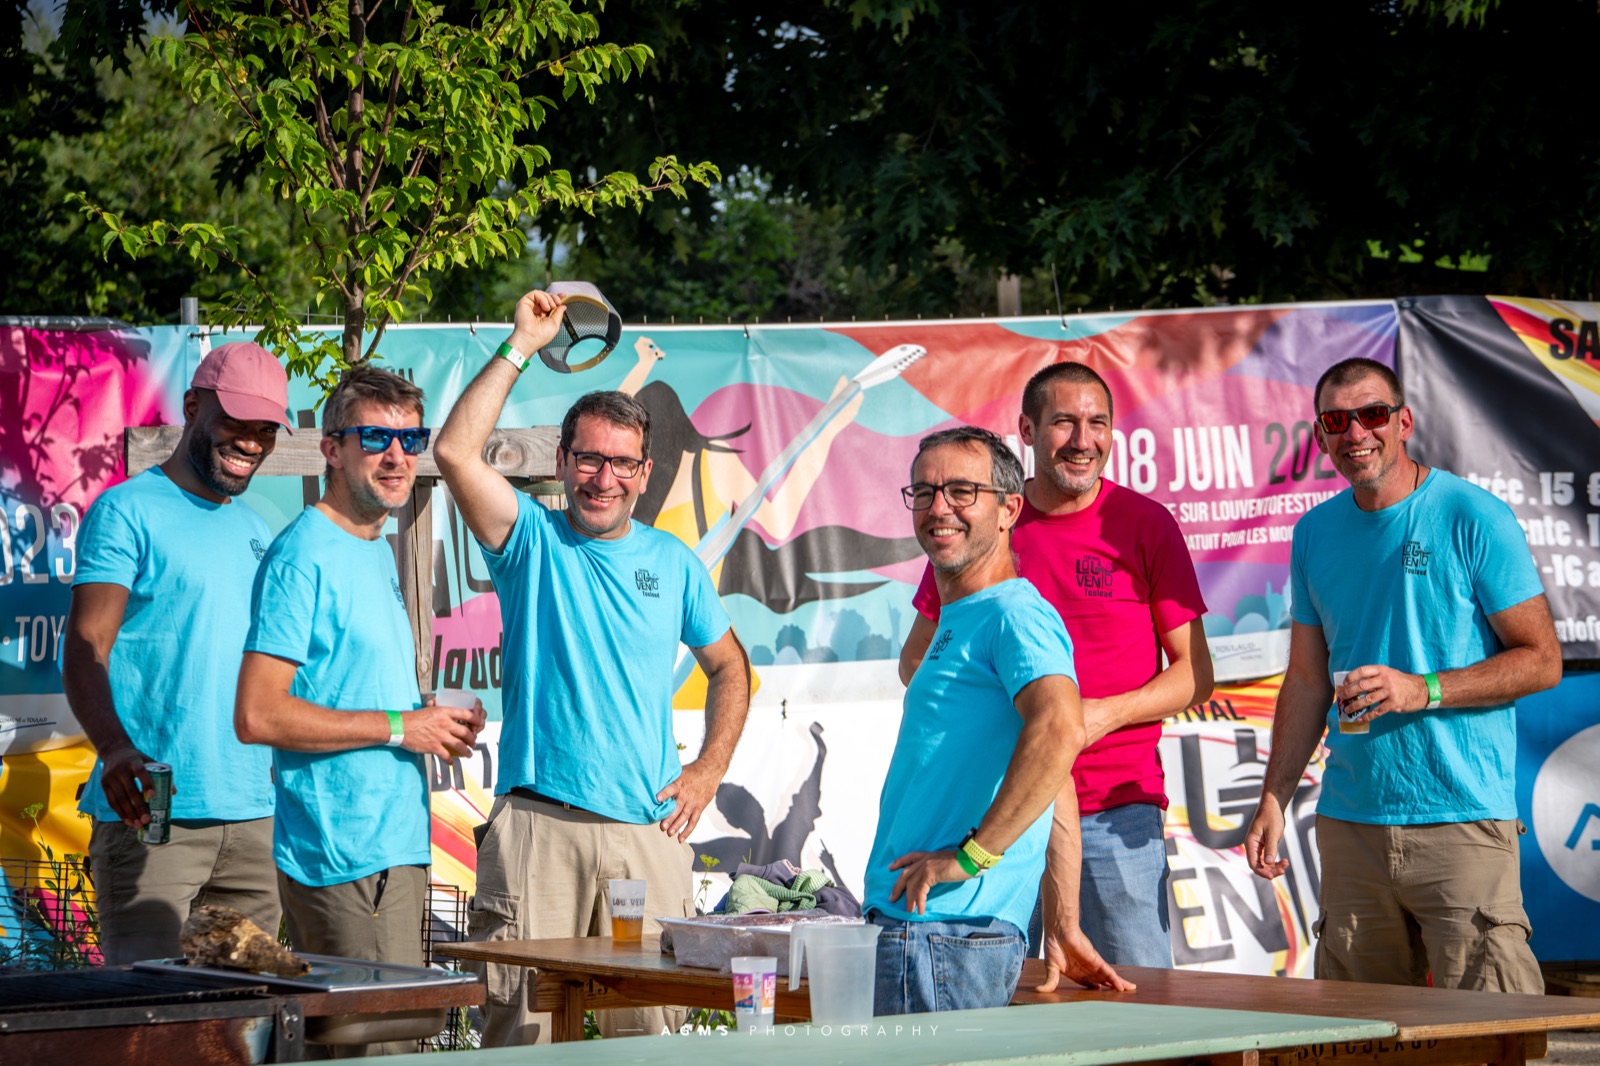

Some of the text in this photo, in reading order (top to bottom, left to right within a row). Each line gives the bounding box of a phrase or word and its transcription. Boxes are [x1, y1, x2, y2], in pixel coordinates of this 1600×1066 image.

[1550, 318, 1600, 360] SA
[1104, 429, 1157, 493] 08
[1170, 424, 1255, 491] JUIN
[1461, 471, 1524, 505] rée
[1179, 501, 1209, 523] SUR
[1211, 490, 1342, 522] LOUVENTOFESTIV
[1221, 531, 1245, 549] POUR
[1246, 527, 1266, 544] LES
[1269, 525, 1294, 542] MOI
[1542, 553, 1585, 587] -16
[1084, 588, 1112, 598] Toulaud
[15, 614, 72, 664] TOY
[1162, 699, 1246, 725] IVAL
